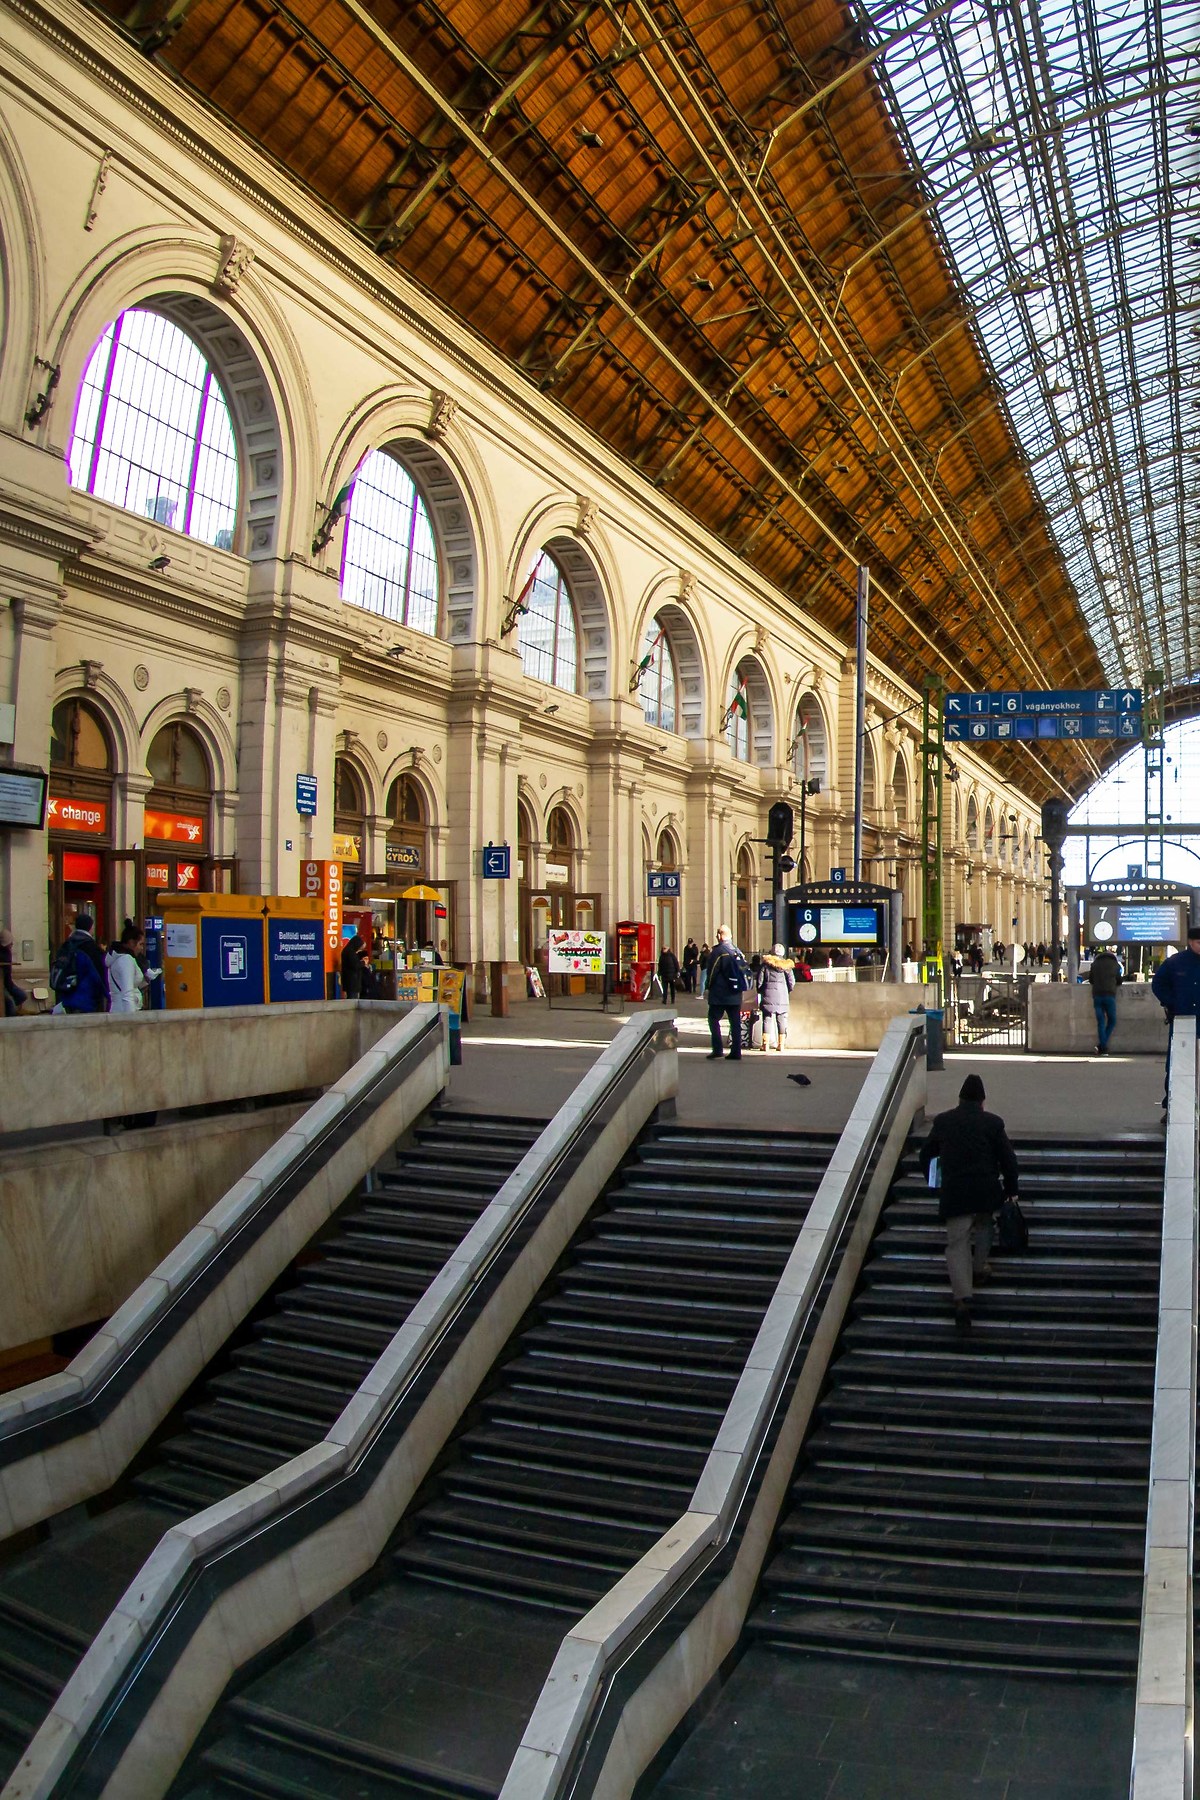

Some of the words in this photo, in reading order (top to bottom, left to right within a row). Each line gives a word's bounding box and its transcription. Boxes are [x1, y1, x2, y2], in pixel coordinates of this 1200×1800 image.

[975, 699, 982, 712] 1
[1007, 698, 1017, 711] 6
[1025, 702, 1081, 712] vágányokhoz
[61, 804, 102, 826] change
[386, 851, 414, 864] GYROS
[834, 871, 842, 881] 6
[1131, 867, 1138, 878] 7
[327, 863, 341, 949] change
[803, 909, 812, 921] 6
[1098, 906, 1108, 920] 7
[278, 931, 299, 940] Belföldi
[279, 943, 315, 952] jegyautomata
